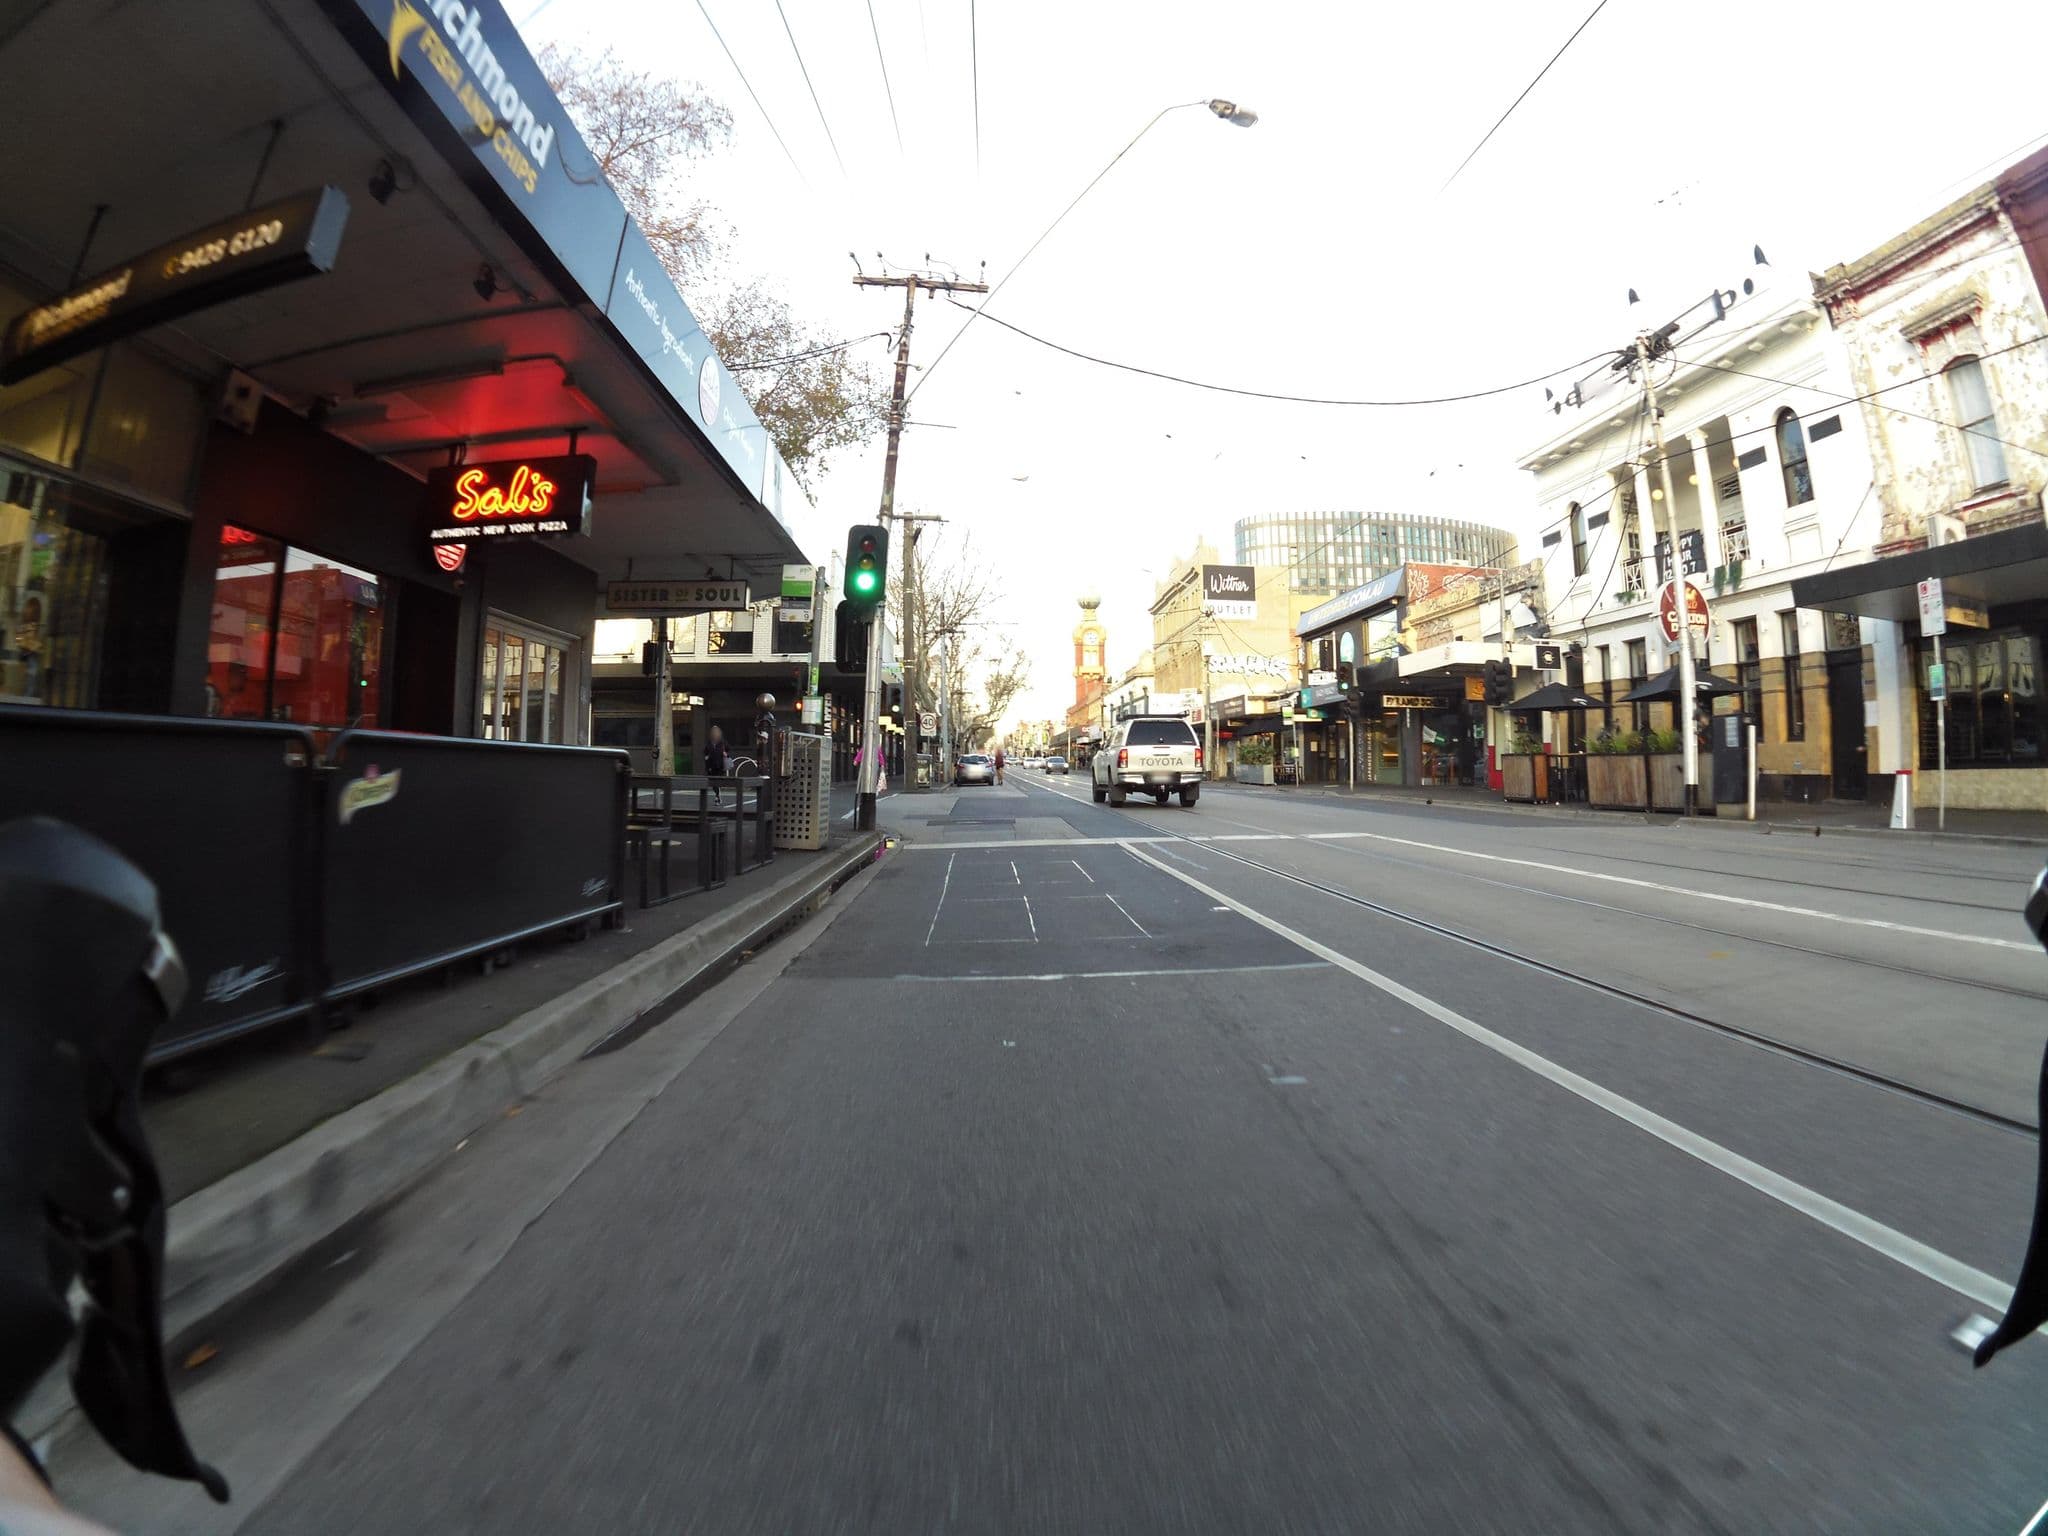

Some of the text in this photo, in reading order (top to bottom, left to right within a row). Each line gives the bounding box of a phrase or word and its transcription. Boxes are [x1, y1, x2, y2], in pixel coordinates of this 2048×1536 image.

[419, 26, 538, 194] FISH AND CHIPS
[453, 465, 554, 518] Sal's
[430, 521, 568, 539] AUTHENTIC NEW YORK PIZZA
[1210, 573, 1249, 594] Wittner
[614, 589, 669, 602] SISTER
[695, 587, 740, 602] SOUL
[1209, 605, 1252, 615] OUTLET
[1667, 610, 1707, 625] CLTON
[923, 718, 934, 726] 40
[1140, 757, 1184, 767] TOYOTA
